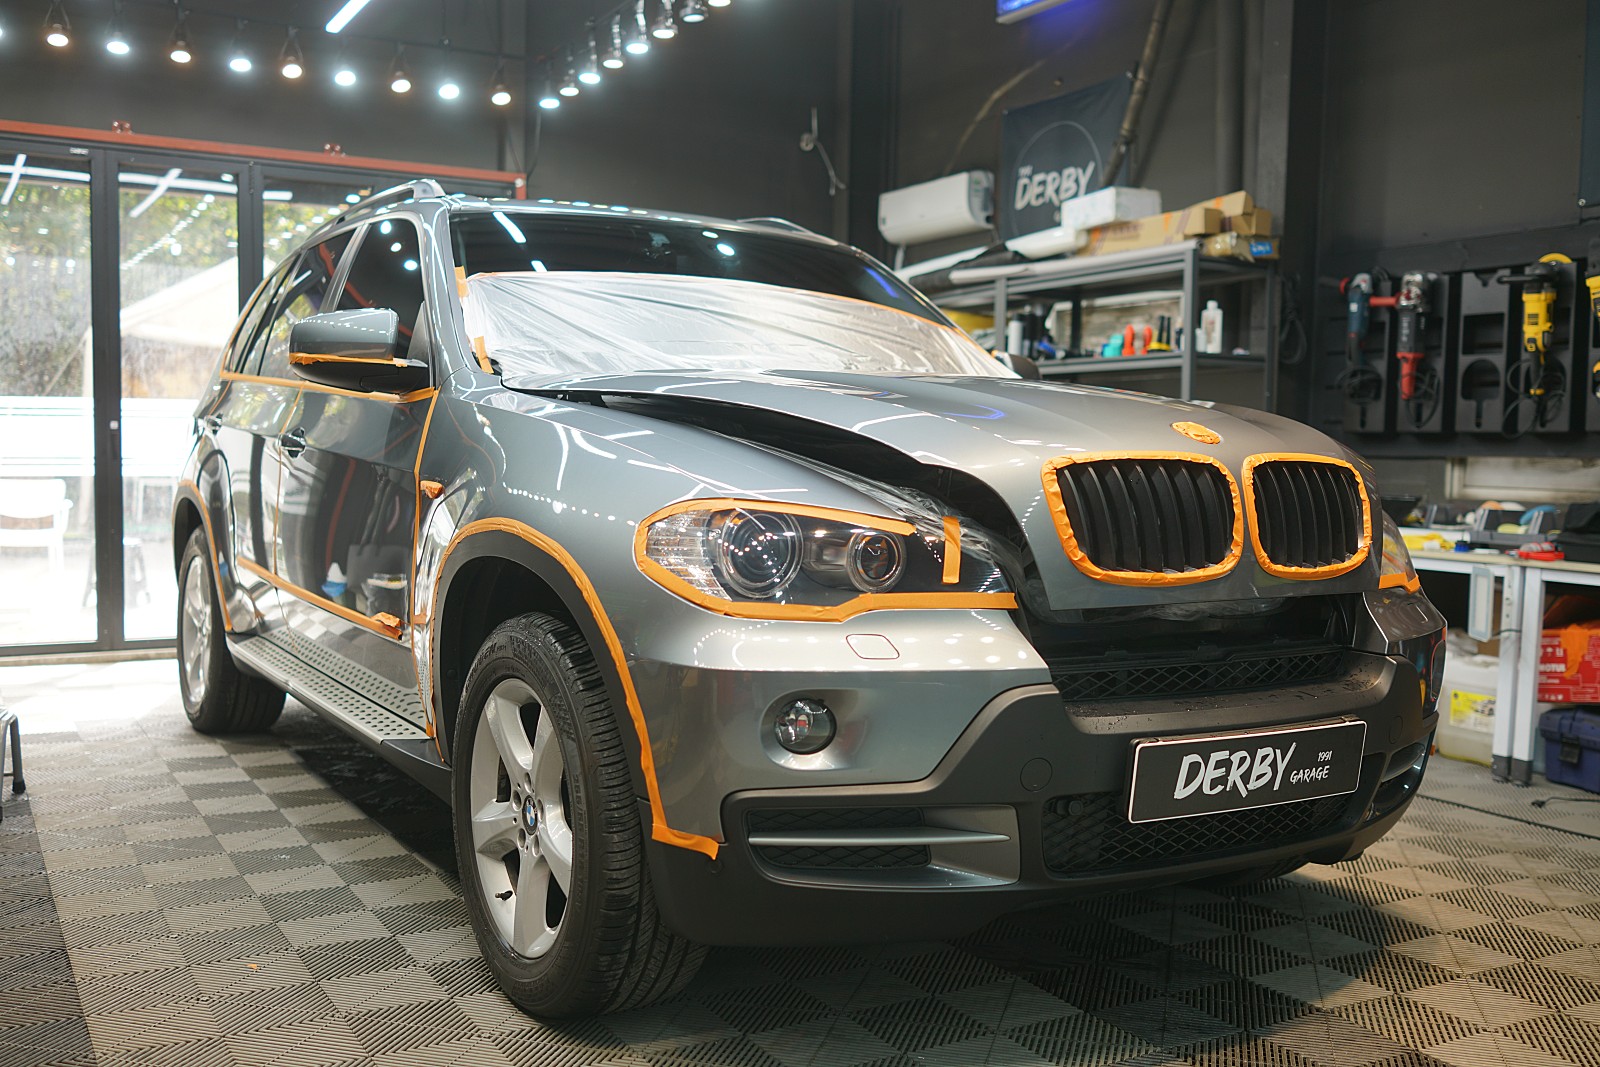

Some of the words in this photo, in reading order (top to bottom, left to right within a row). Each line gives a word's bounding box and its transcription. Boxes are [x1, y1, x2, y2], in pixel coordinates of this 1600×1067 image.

[1014, 160, 1096, 211] DERBY
[1173, 742, 1297, 800] DERBY
[1290, 765, 1330, 785] GARAGE
[1317, 750, 1333, 762] 1991
